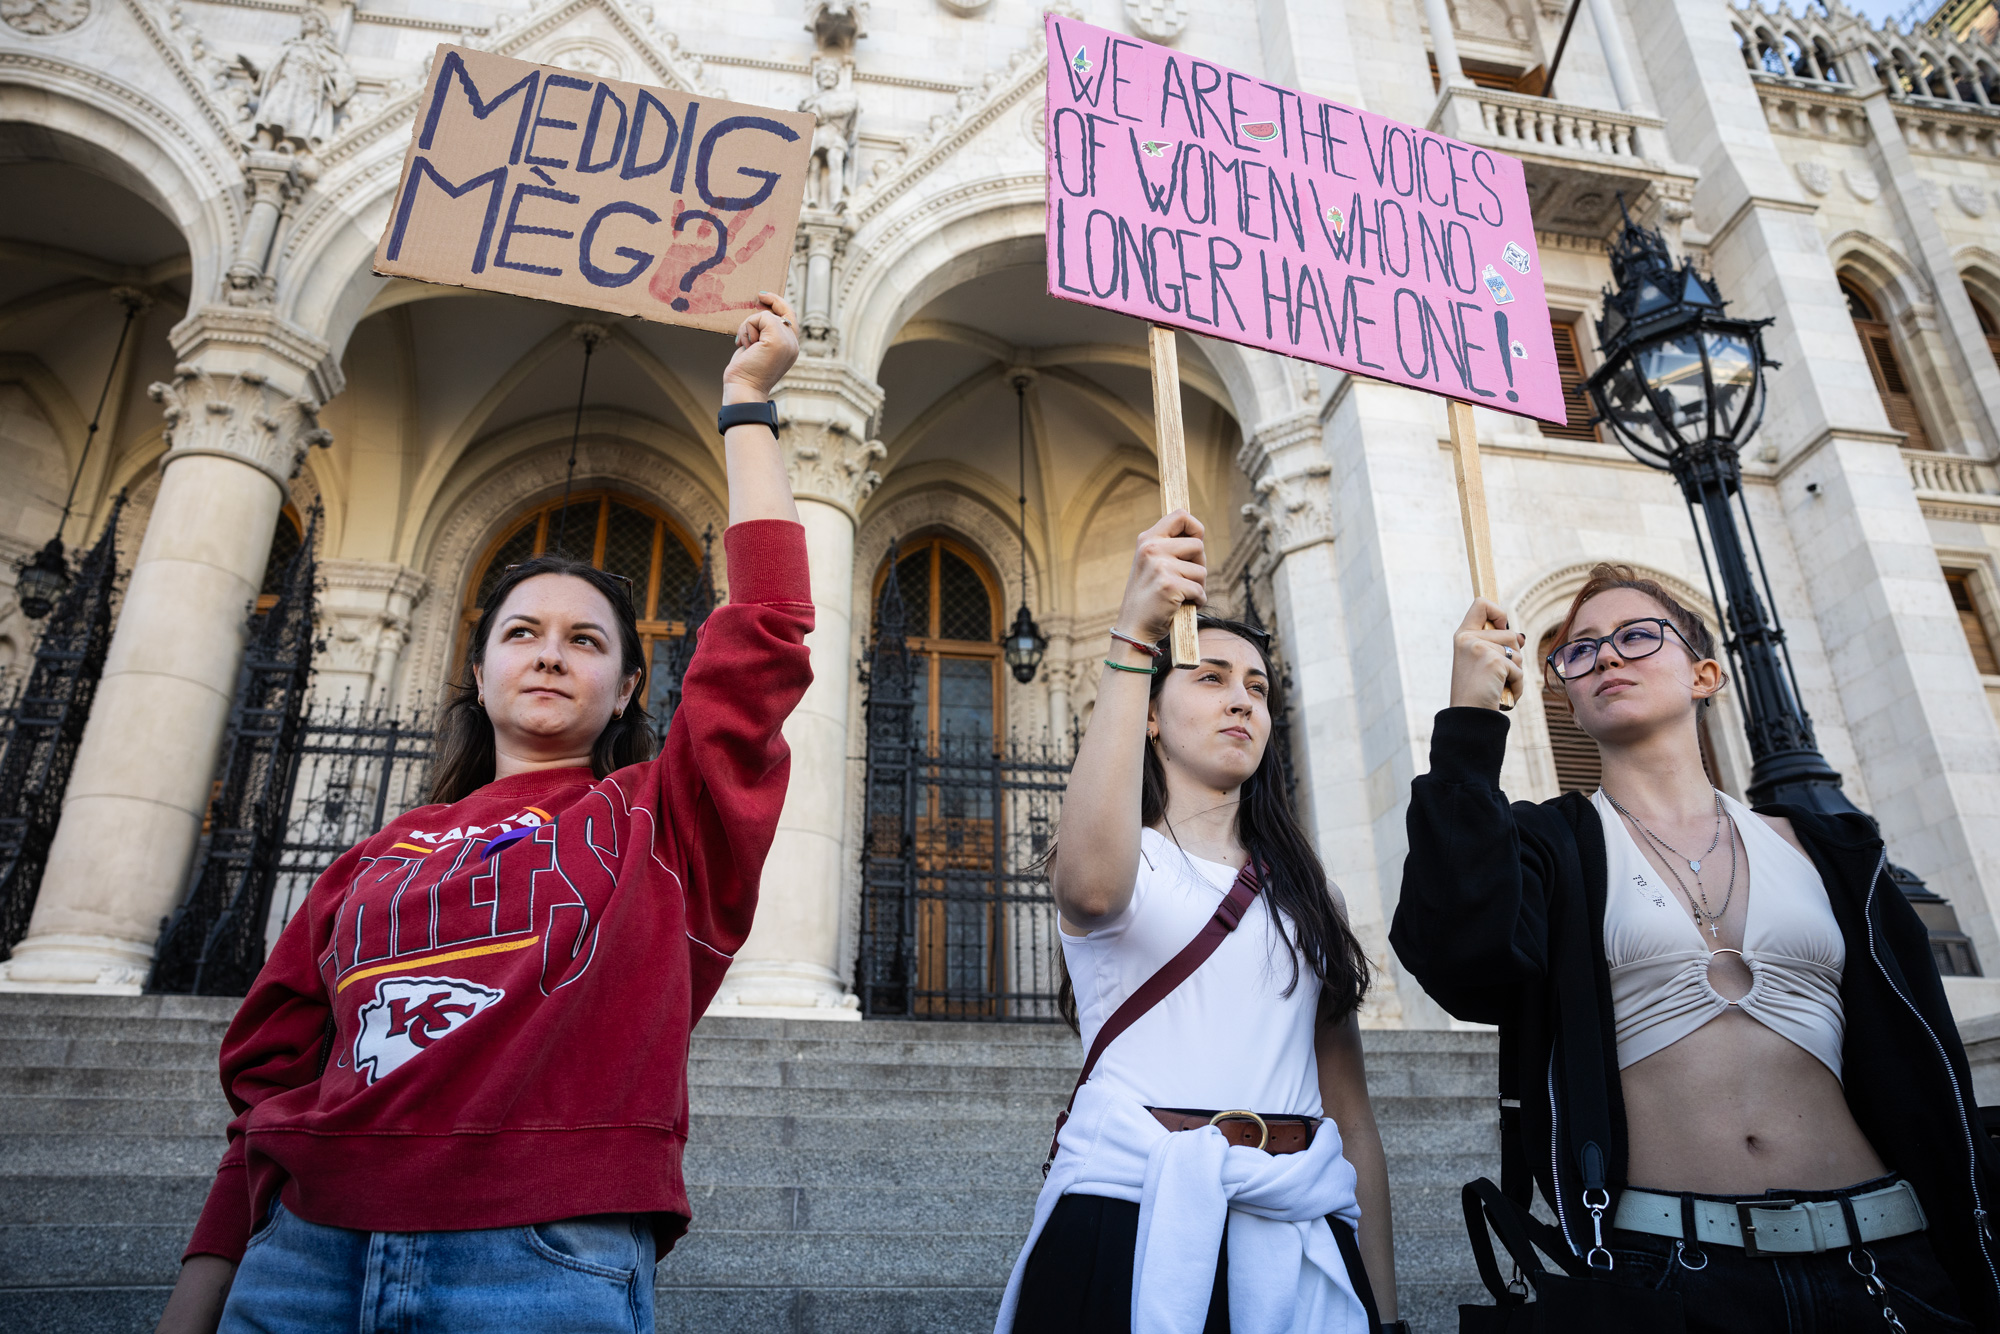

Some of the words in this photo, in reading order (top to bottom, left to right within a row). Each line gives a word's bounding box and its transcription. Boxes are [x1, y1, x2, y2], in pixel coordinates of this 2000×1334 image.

[419, 51, 800, 211] MEDDIG
[1055, 22, 1143, 122] WE
[1161, 56, 1261, 153] ARE
[1247, 83, 1357, 180] THE
[1054, 107, 1119, 197] OF
[1129, 127, 1306, 252] WOMEN
[1308, 179, 1410, 276] WHO
[1418, 211, 1477, 294] NO
[1057, 198, 1246, 331] LONGER
[1259, 249, 1384, 371] HAVE
[1394, 289, 1519, 402] ONE!
